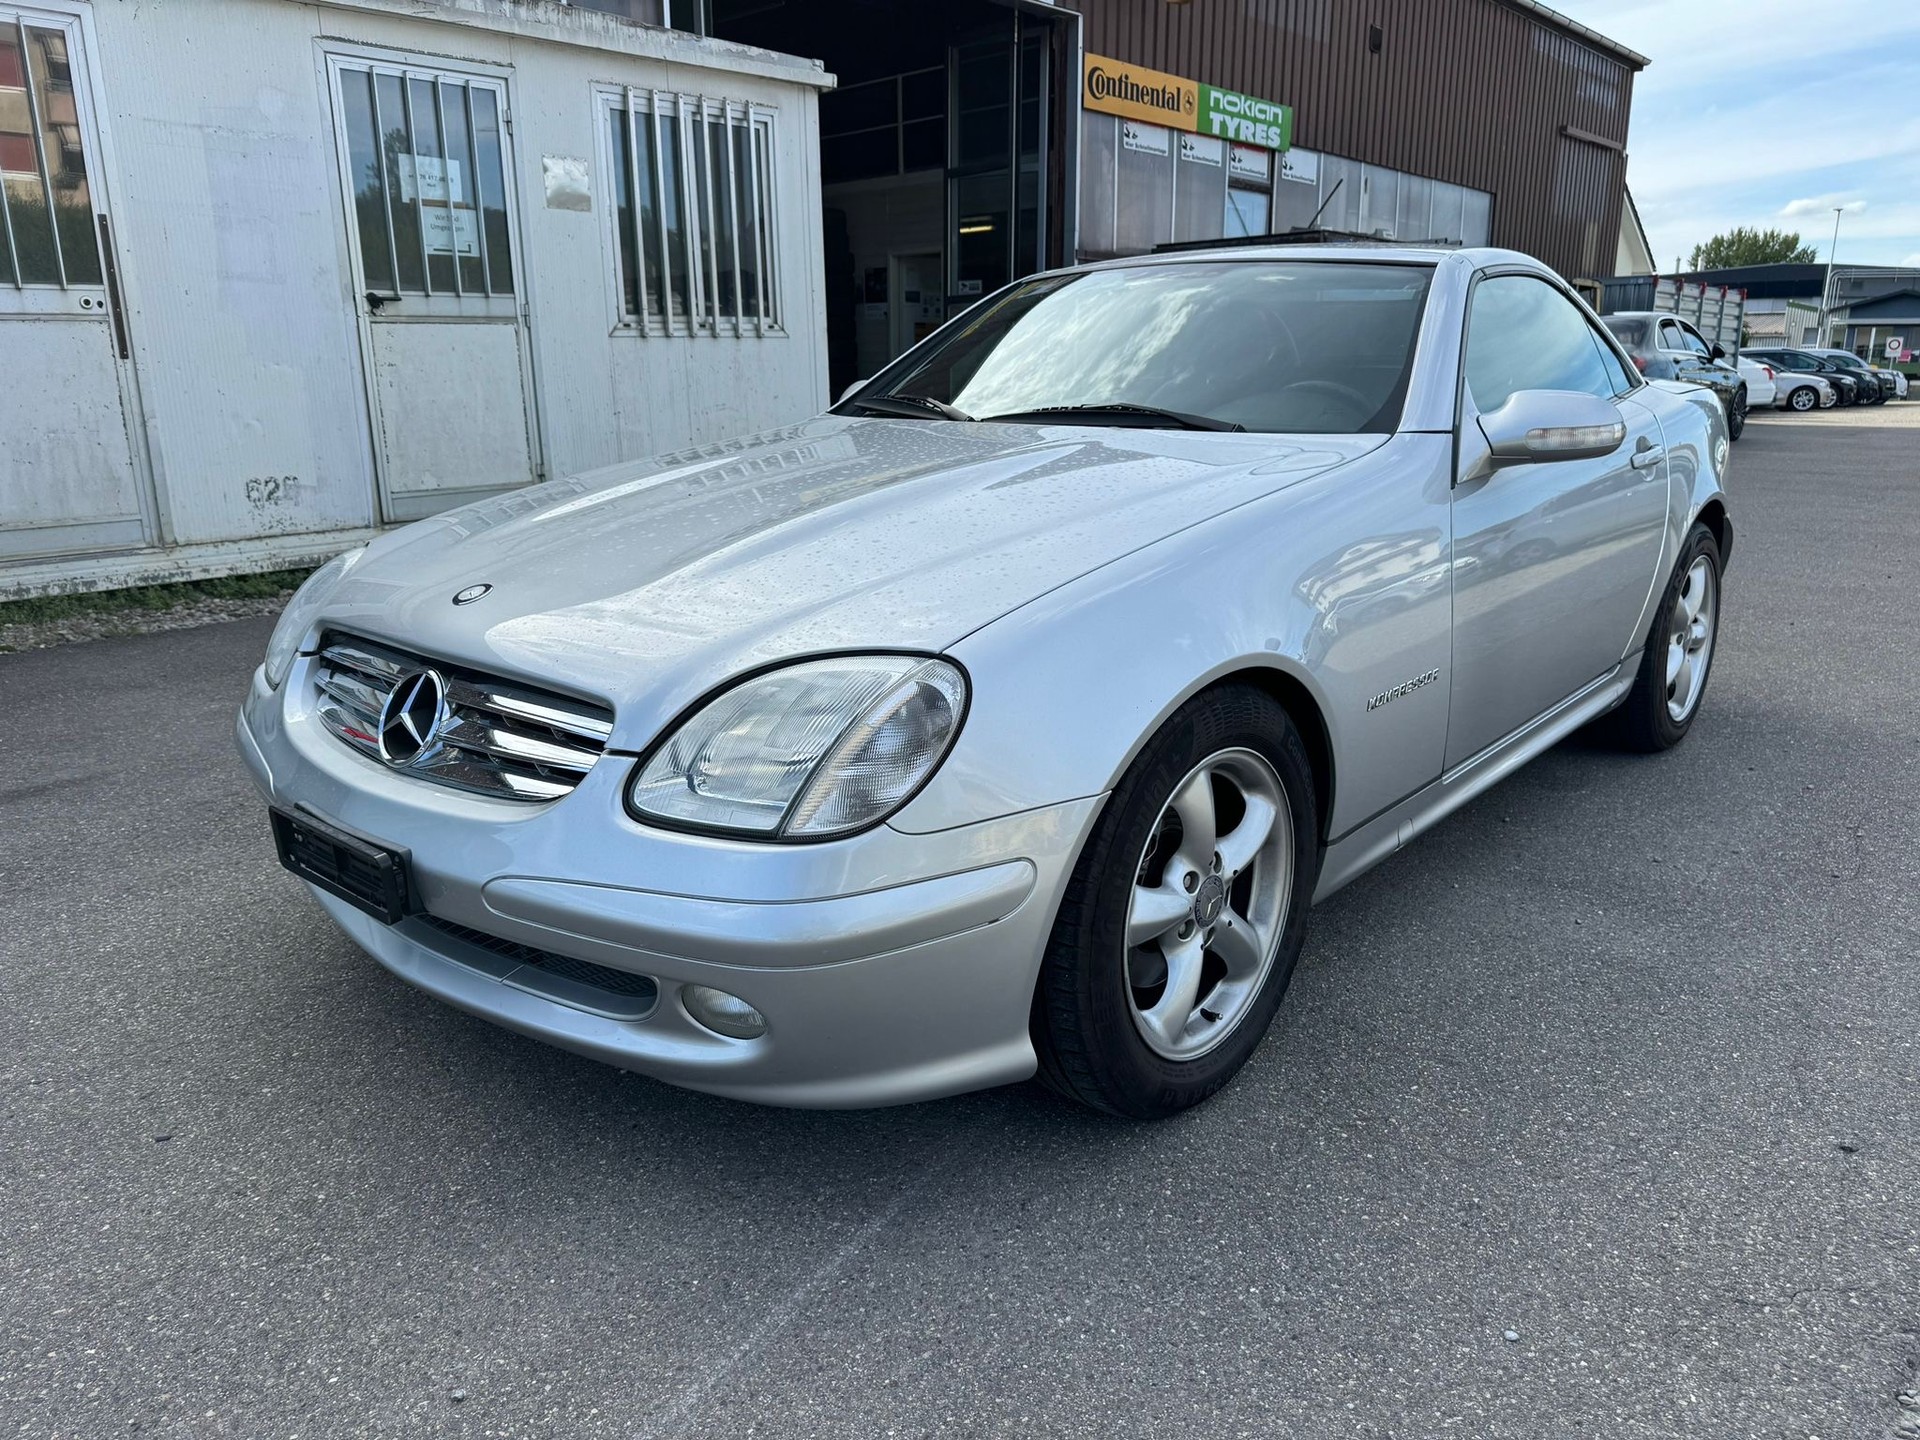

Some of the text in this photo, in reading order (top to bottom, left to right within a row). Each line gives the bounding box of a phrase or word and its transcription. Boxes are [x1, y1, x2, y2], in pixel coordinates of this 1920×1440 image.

[1087, 65, 1181, 113] Continental
[1209, 111, 1281, 148] TYRES
[1366, 667, 1440, 713] KOMPRESSOR
